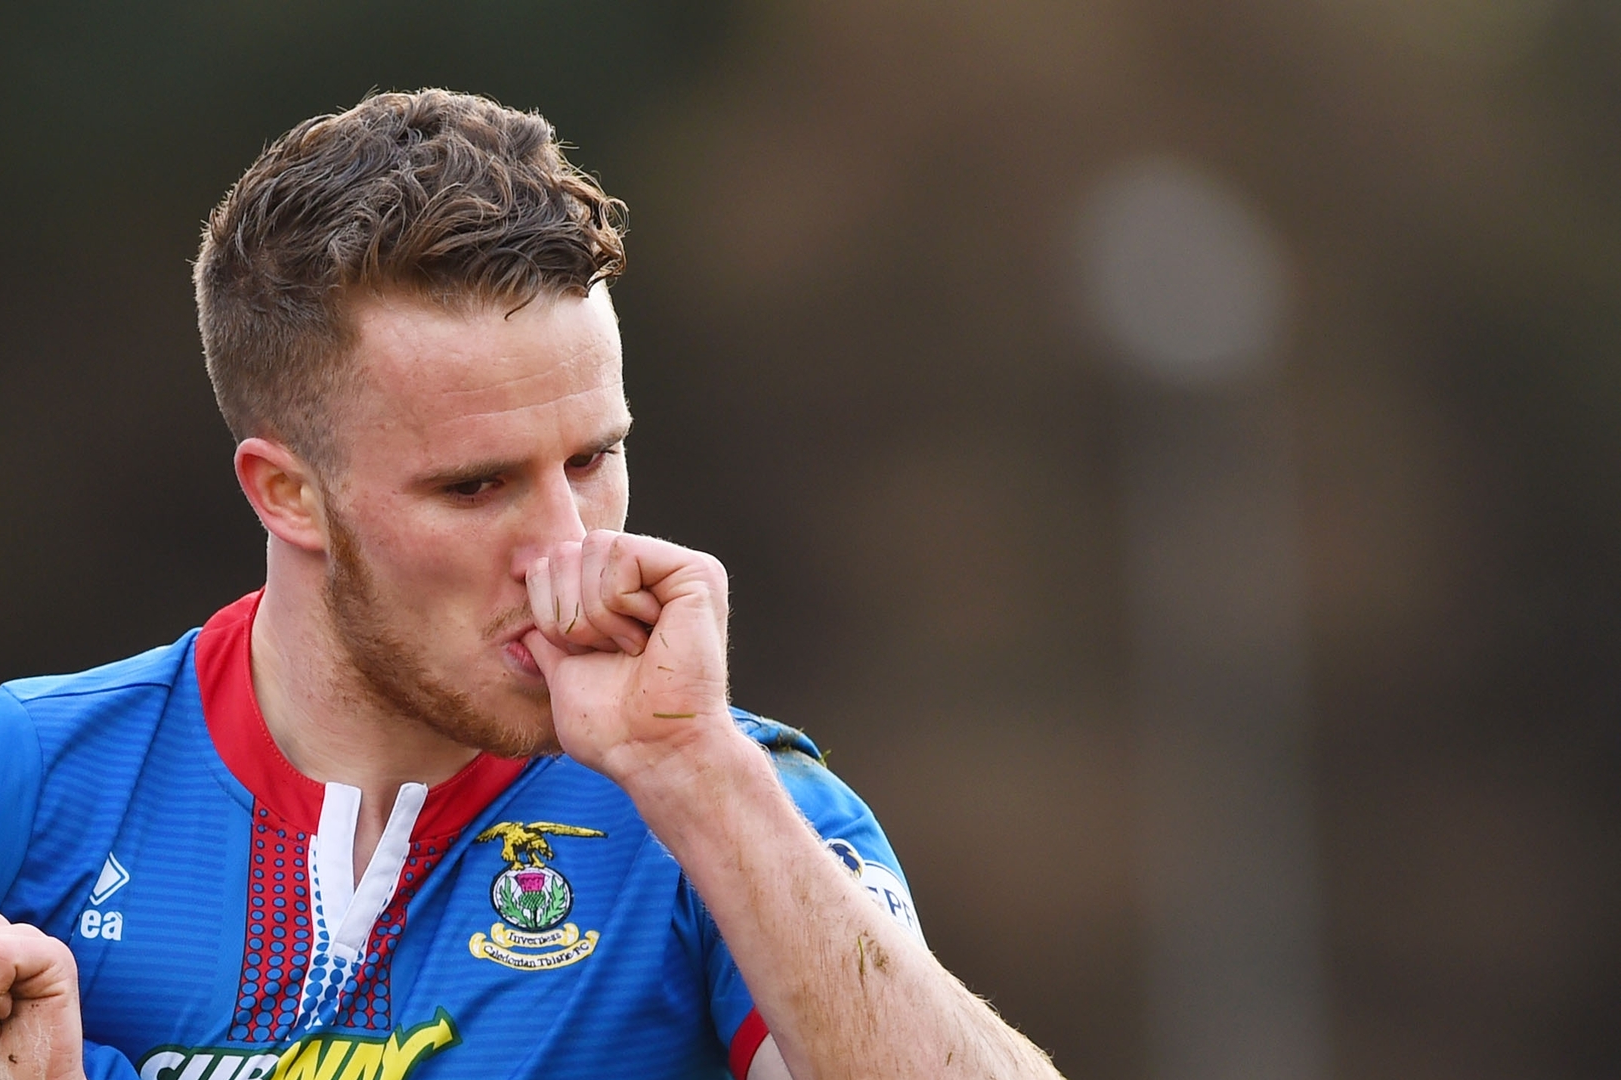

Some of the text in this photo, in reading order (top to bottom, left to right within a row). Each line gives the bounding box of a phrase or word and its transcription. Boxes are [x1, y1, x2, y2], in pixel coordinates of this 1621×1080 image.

[80, 909, 123, 941] ea
[508, 931, 562, 945] Inverness
[484, 944, 536, 968] Caledonian
[573, 941, 590, 956] FC
